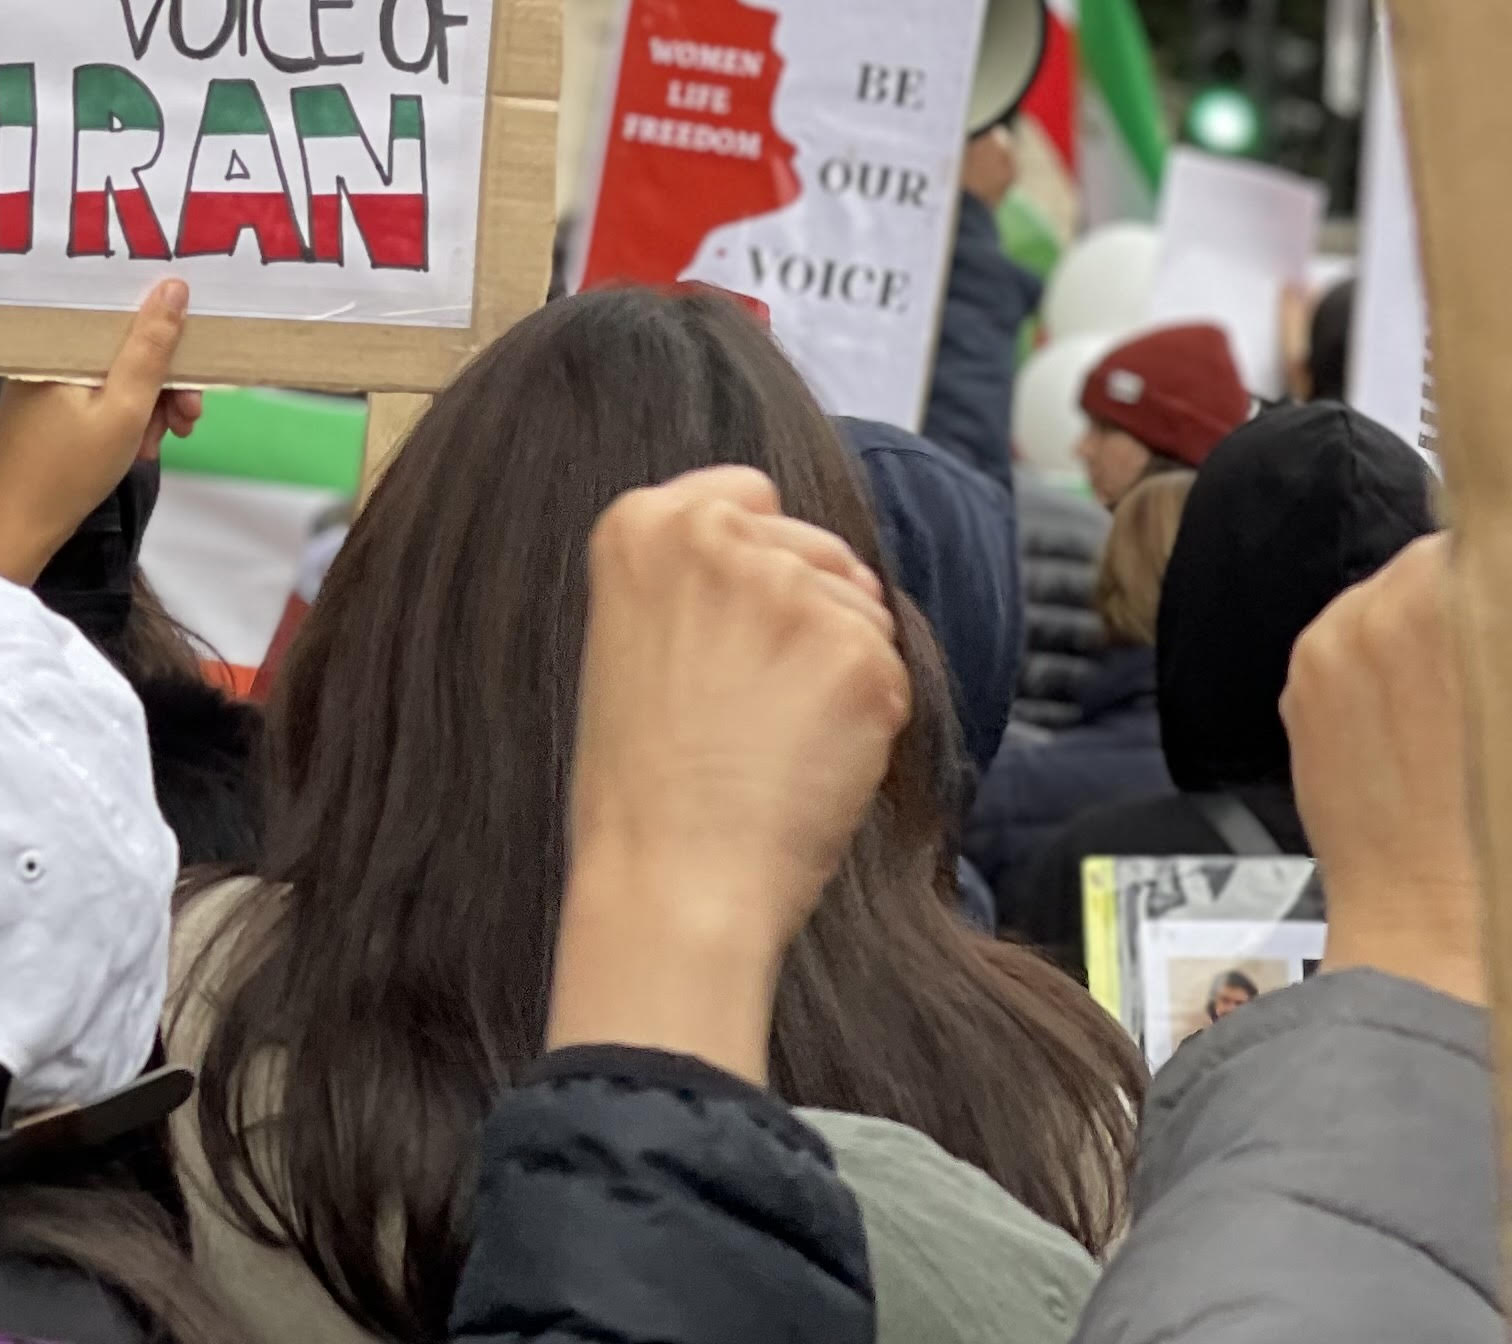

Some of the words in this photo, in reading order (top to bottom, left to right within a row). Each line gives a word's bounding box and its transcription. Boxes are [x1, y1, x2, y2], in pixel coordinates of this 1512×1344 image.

[649, 36, 765, 78] WOMEN
[666, 79, 732, 115] LIFE
[855, 62, 928, 112] BE
[621, 113, 762, 161] FREEDOM
[818, 155, 929, 207] OUR
[747, 246, 913, 313] VOICE
